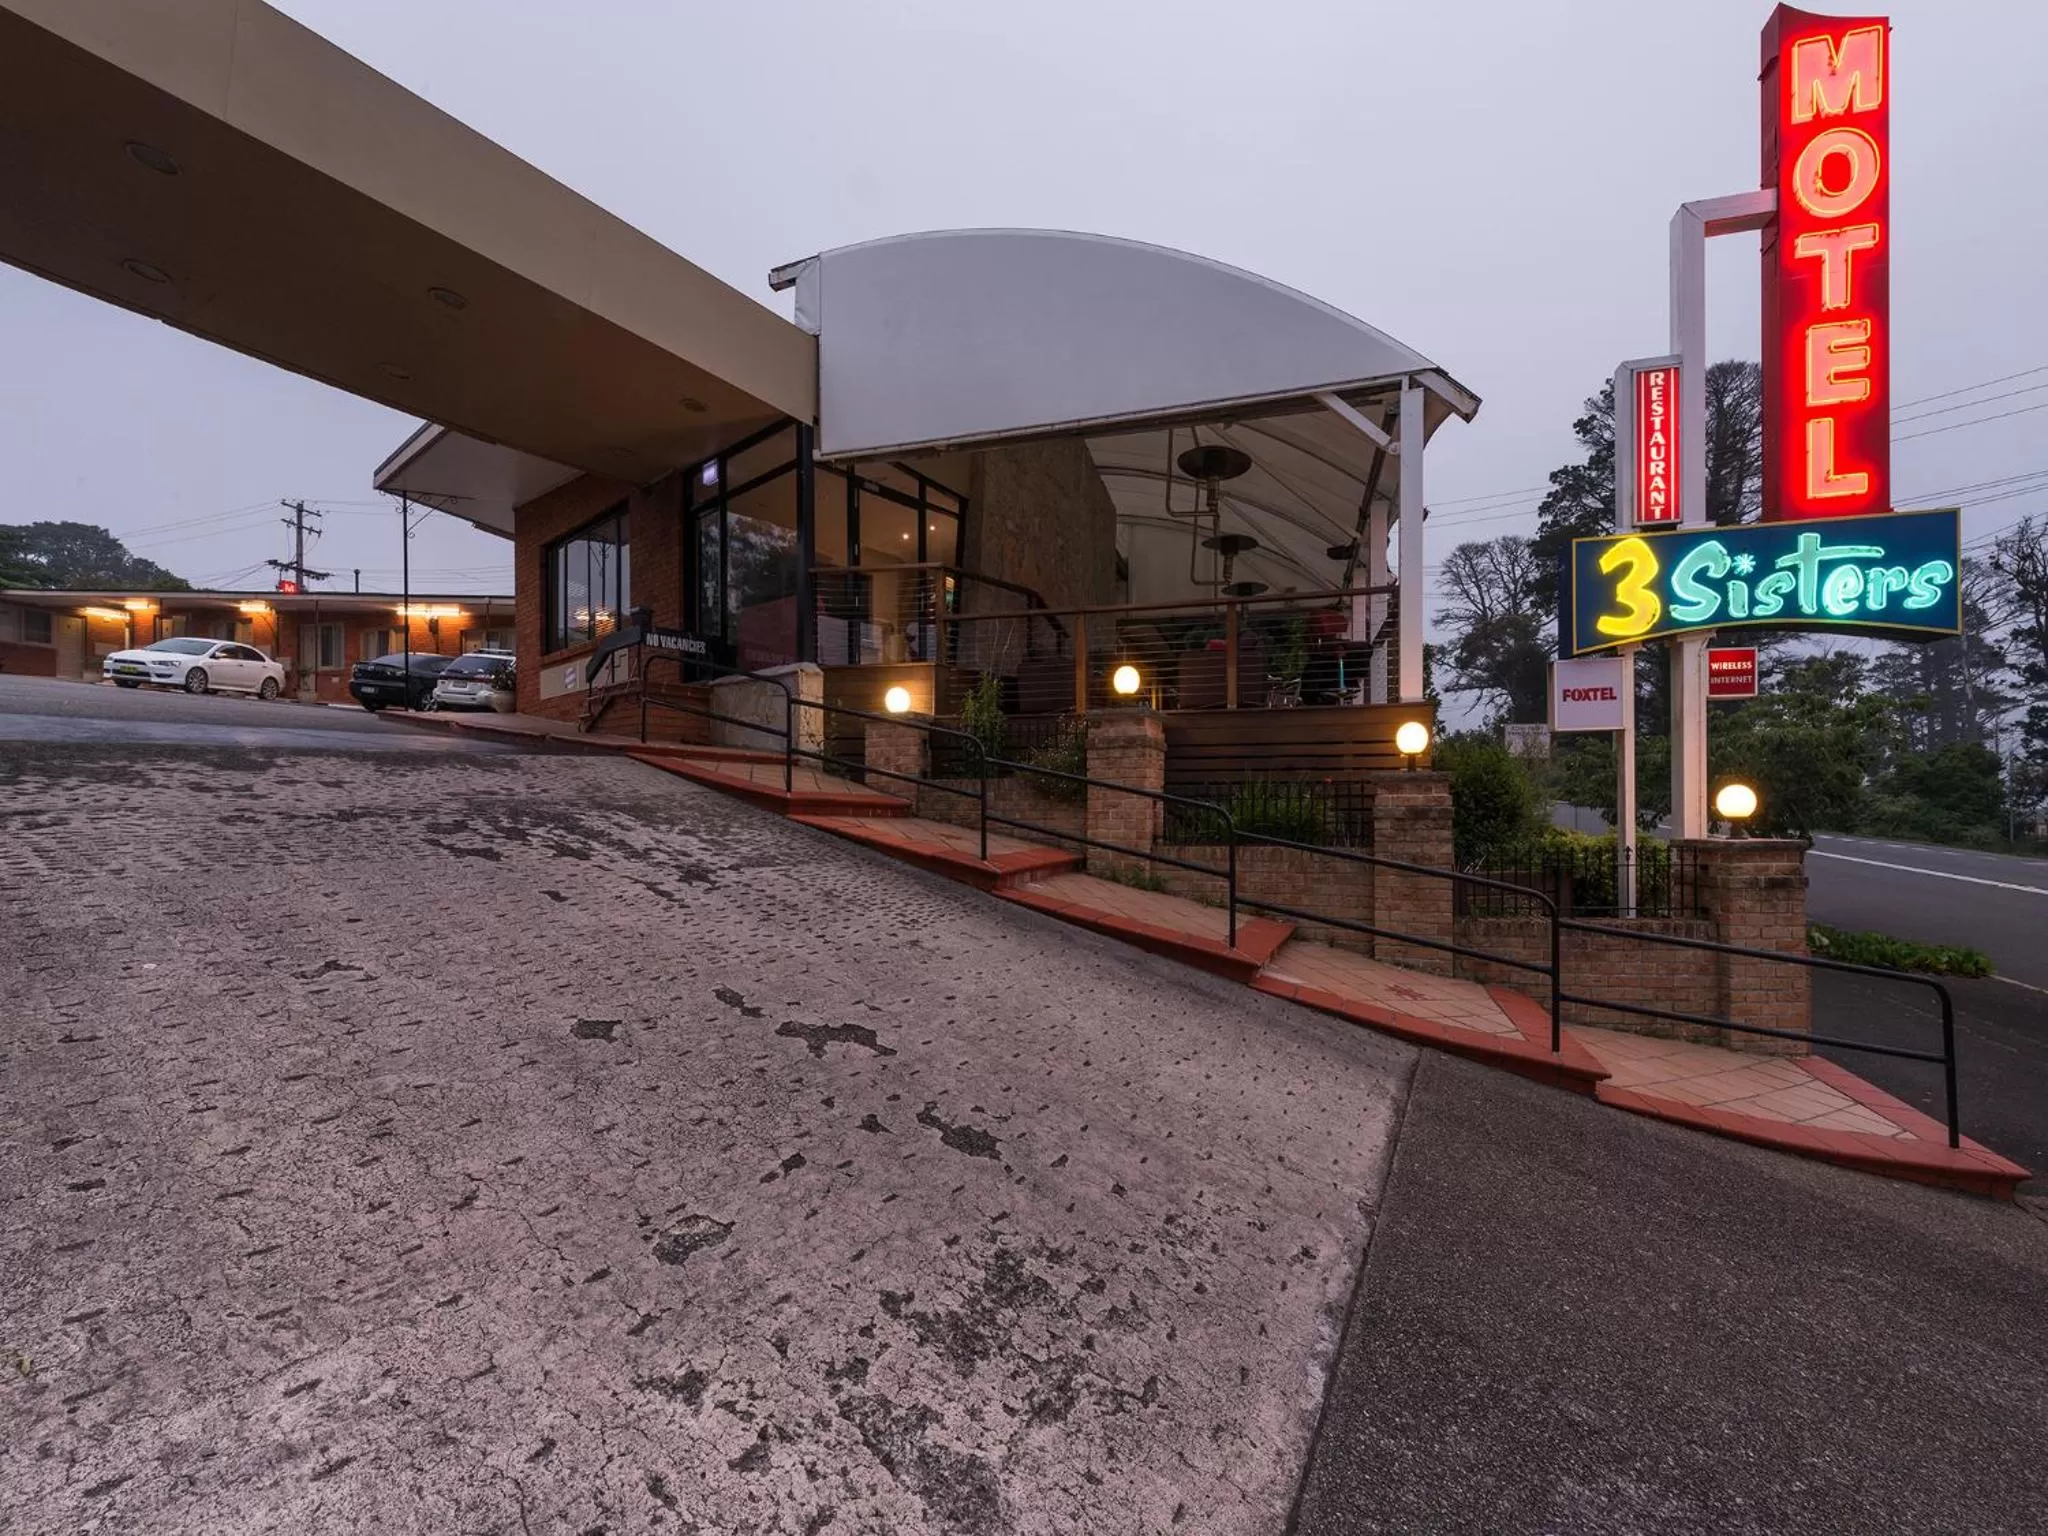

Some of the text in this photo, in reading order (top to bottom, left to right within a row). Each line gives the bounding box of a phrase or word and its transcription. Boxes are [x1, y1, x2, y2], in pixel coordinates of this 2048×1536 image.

[1790, 25, 1884, 501] MOTEL
[1649, 371, 1666, 520] RESTAURANT
[1596, 532, 1955, 636] 3 Sisters
[646, 633, 706, 653] NO VACANCIES
[1710, 661, 1752, 670] WIRELESS
[1710, 675, 1752, 684] INTERNET
[1562, 687, 1617, 702] FOXTEL
